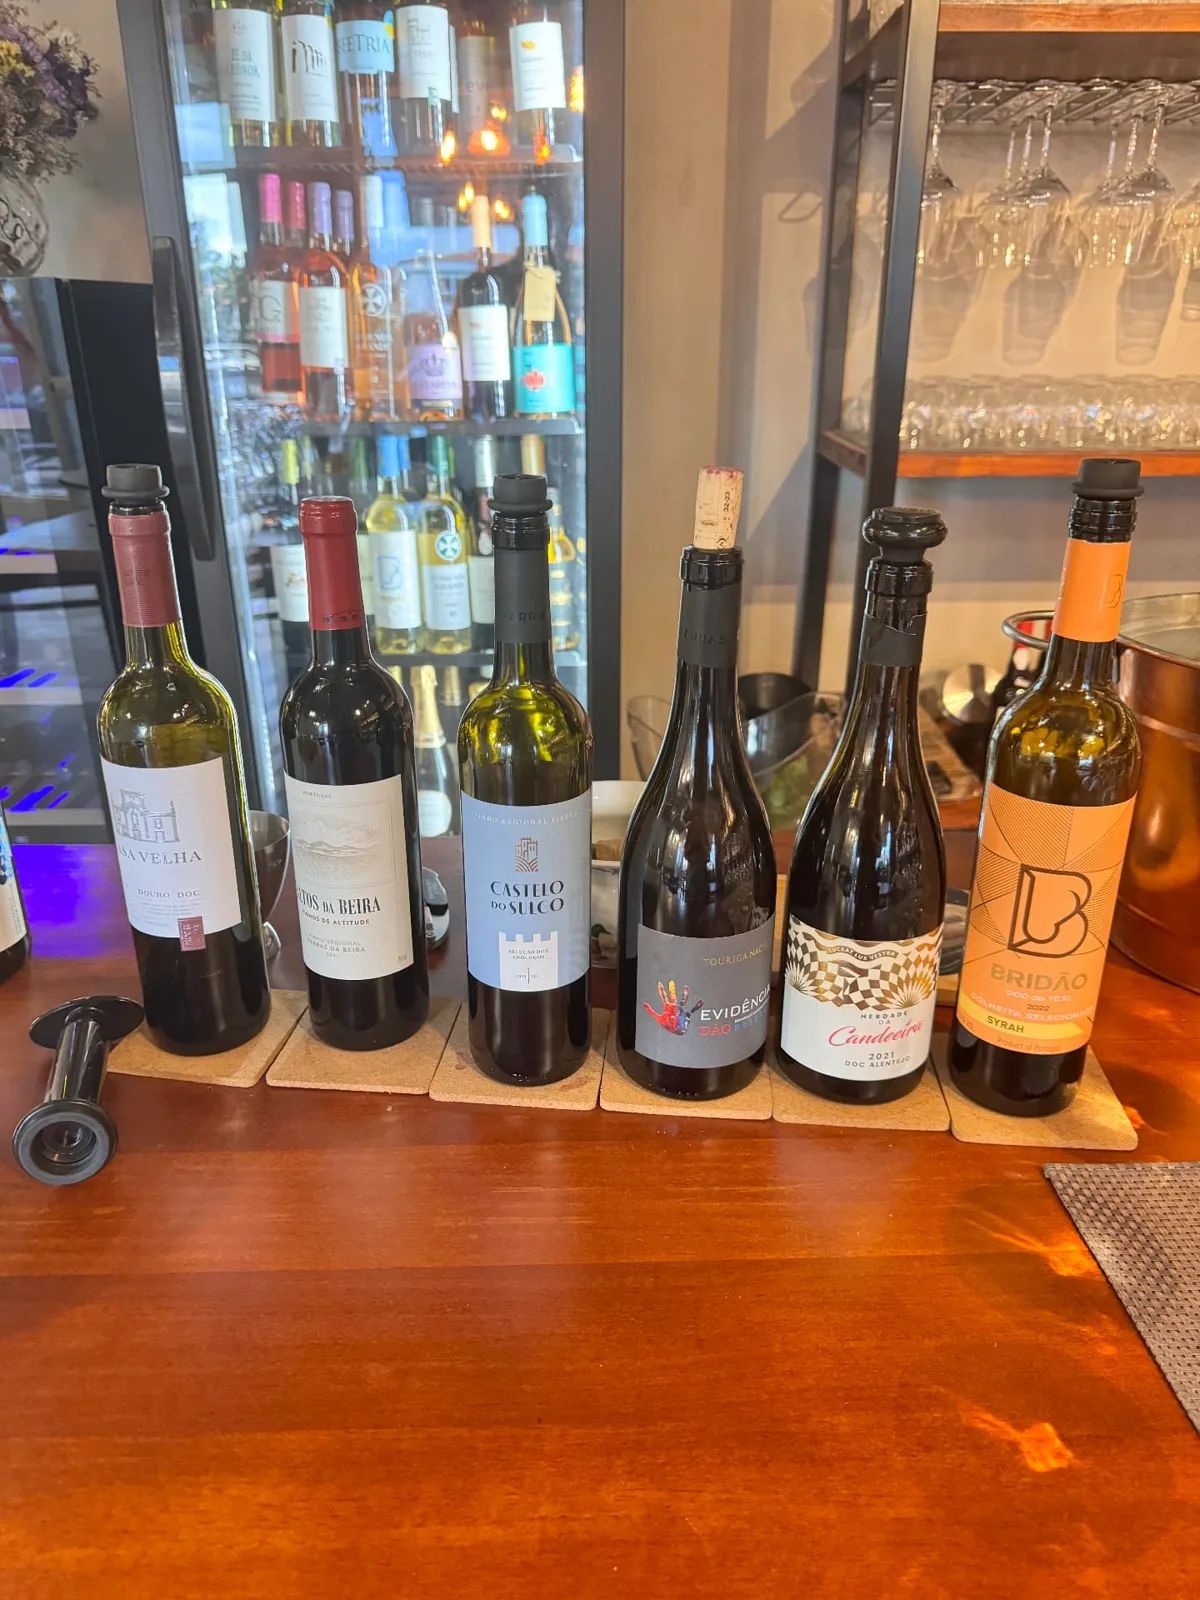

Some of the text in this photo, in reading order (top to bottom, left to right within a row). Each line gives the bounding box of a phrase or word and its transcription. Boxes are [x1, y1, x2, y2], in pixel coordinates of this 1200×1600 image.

[137, 850, 202, 865] VELHA
[138, 888, 201, 899] DOURO DOC
[489, 879, 565, 899] CASTELO
[322, 900, 334, 914] DA
[338, 895, 381, 915] BEIRA
[509, 897, 565, 916] SULCO
[321, 917, 331, 925] DE
[703, 953, 748, 967] TOURIGA
[854, 951, 868, 961] LUX
[989, 962, 1089, 992] BRIDÃO
[860, 1010, 908, 1020] HERDADE
[986, 1014, 1025, 1034] SYRAH
[844, 1055, 912, 1068] DOC ALENTEJO
[868, 1051, 896, 1061] 2021
